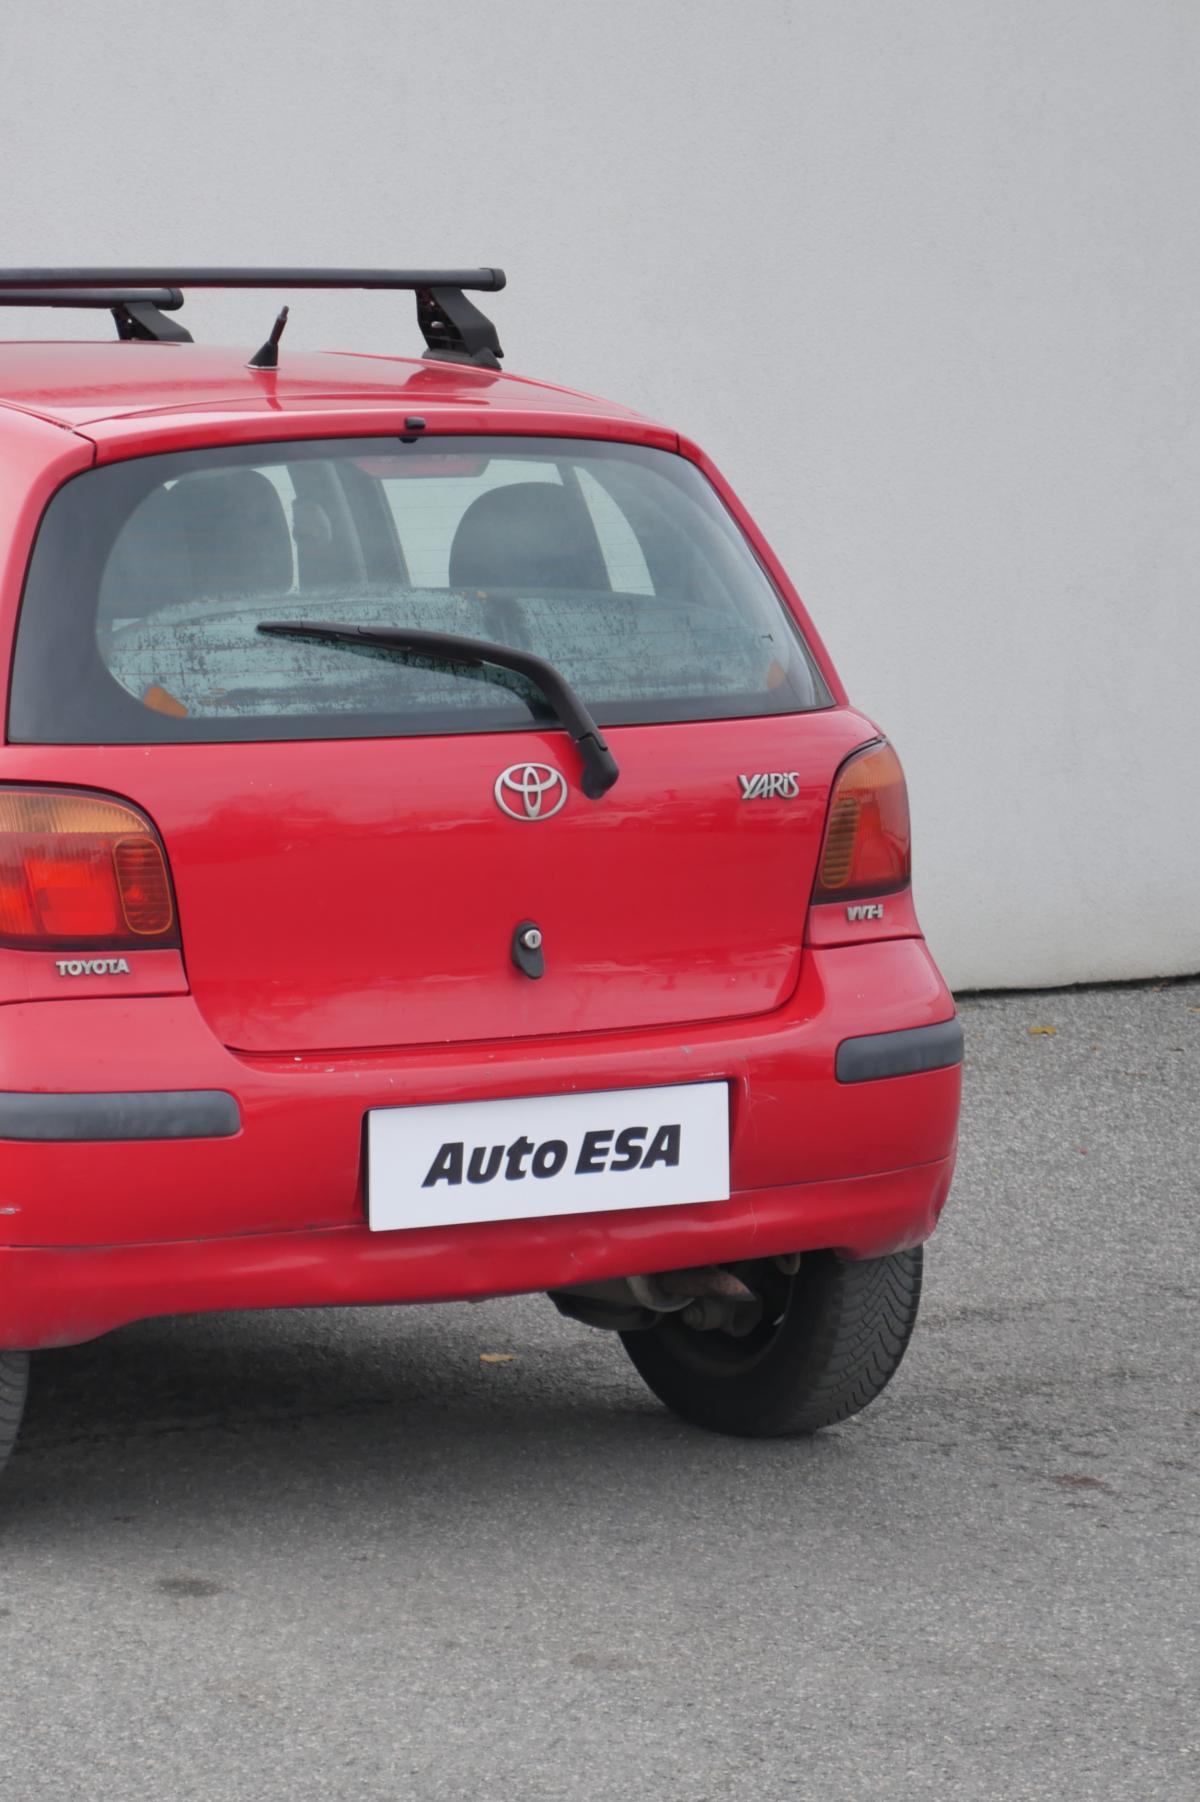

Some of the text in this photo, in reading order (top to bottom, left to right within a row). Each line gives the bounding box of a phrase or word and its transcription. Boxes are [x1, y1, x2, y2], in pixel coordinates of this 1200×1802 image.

[55, 958, 131, 977] TOYOTA
[420, 1123, 682, 1188] Auto ESA
